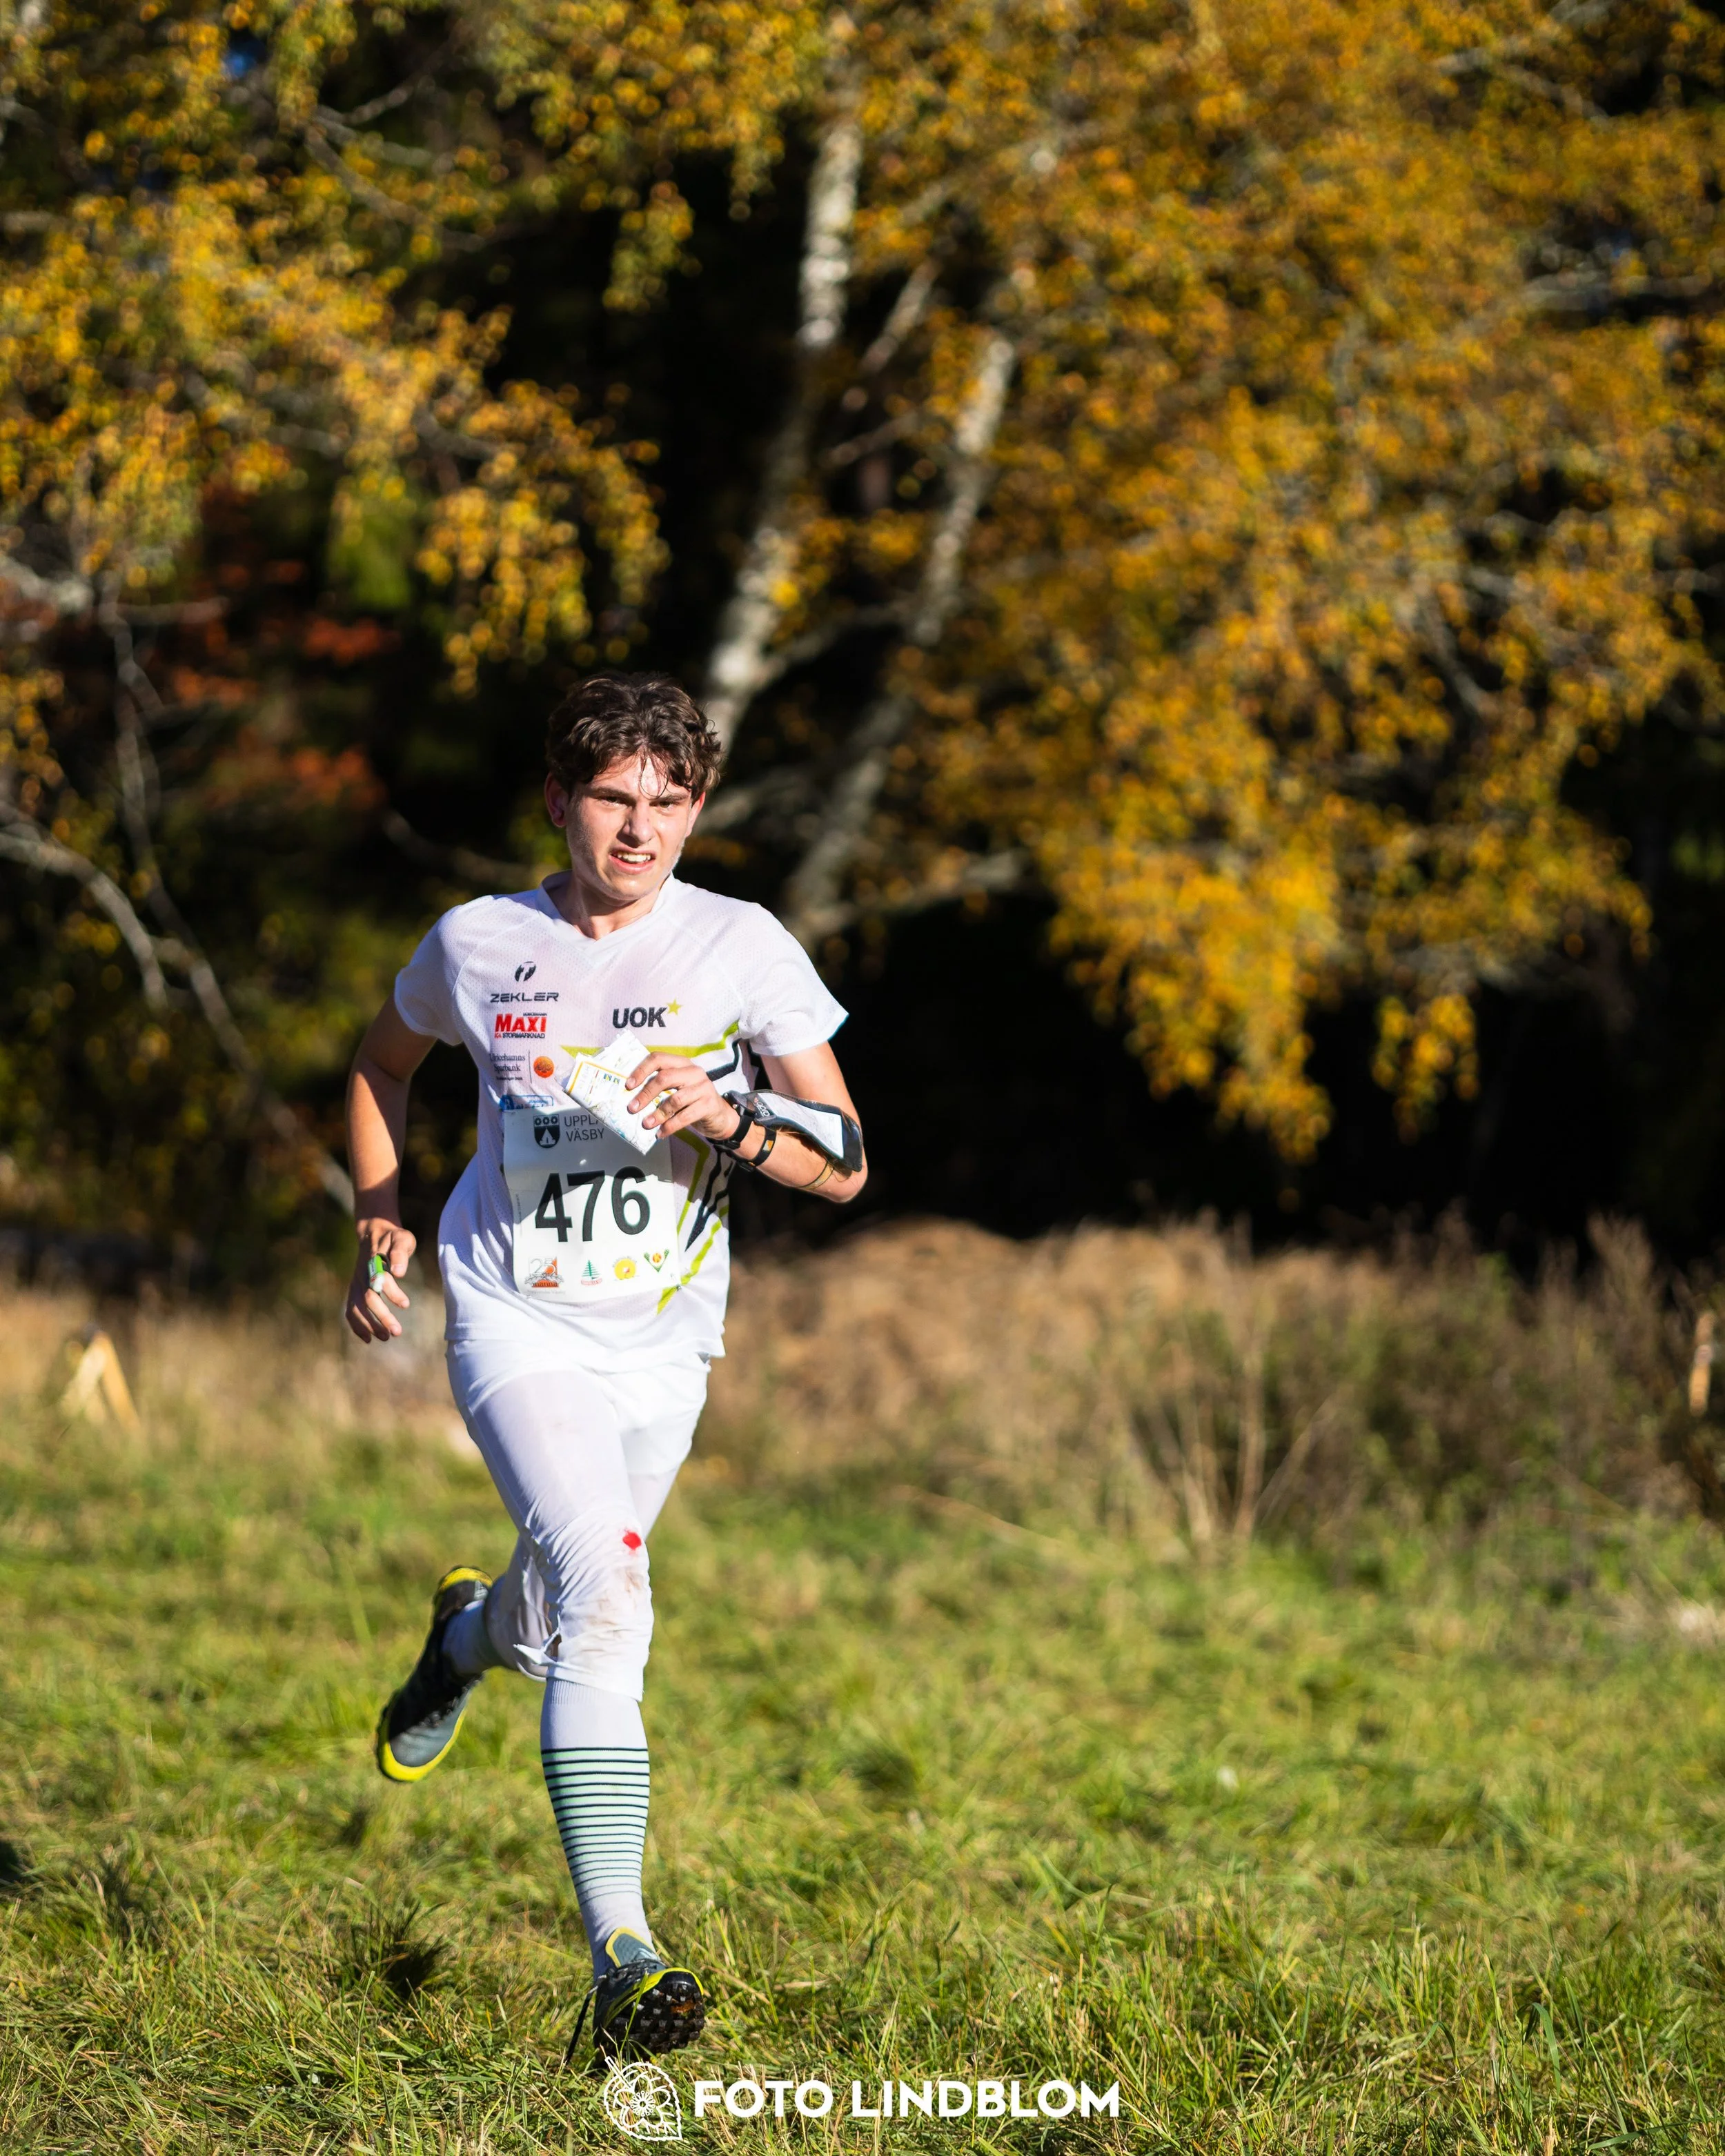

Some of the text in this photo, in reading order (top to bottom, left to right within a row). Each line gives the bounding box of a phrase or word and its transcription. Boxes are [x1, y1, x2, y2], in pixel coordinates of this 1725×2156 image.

[490, 992, 560, 1002] ZEKLER
[495, 1013, 546, 1032] MAXI
[613, 1007, 667, 1029] UOK
[566, 1127, 604, 1142] VÄSBY
[535, 1166, 650, 1242] 476
